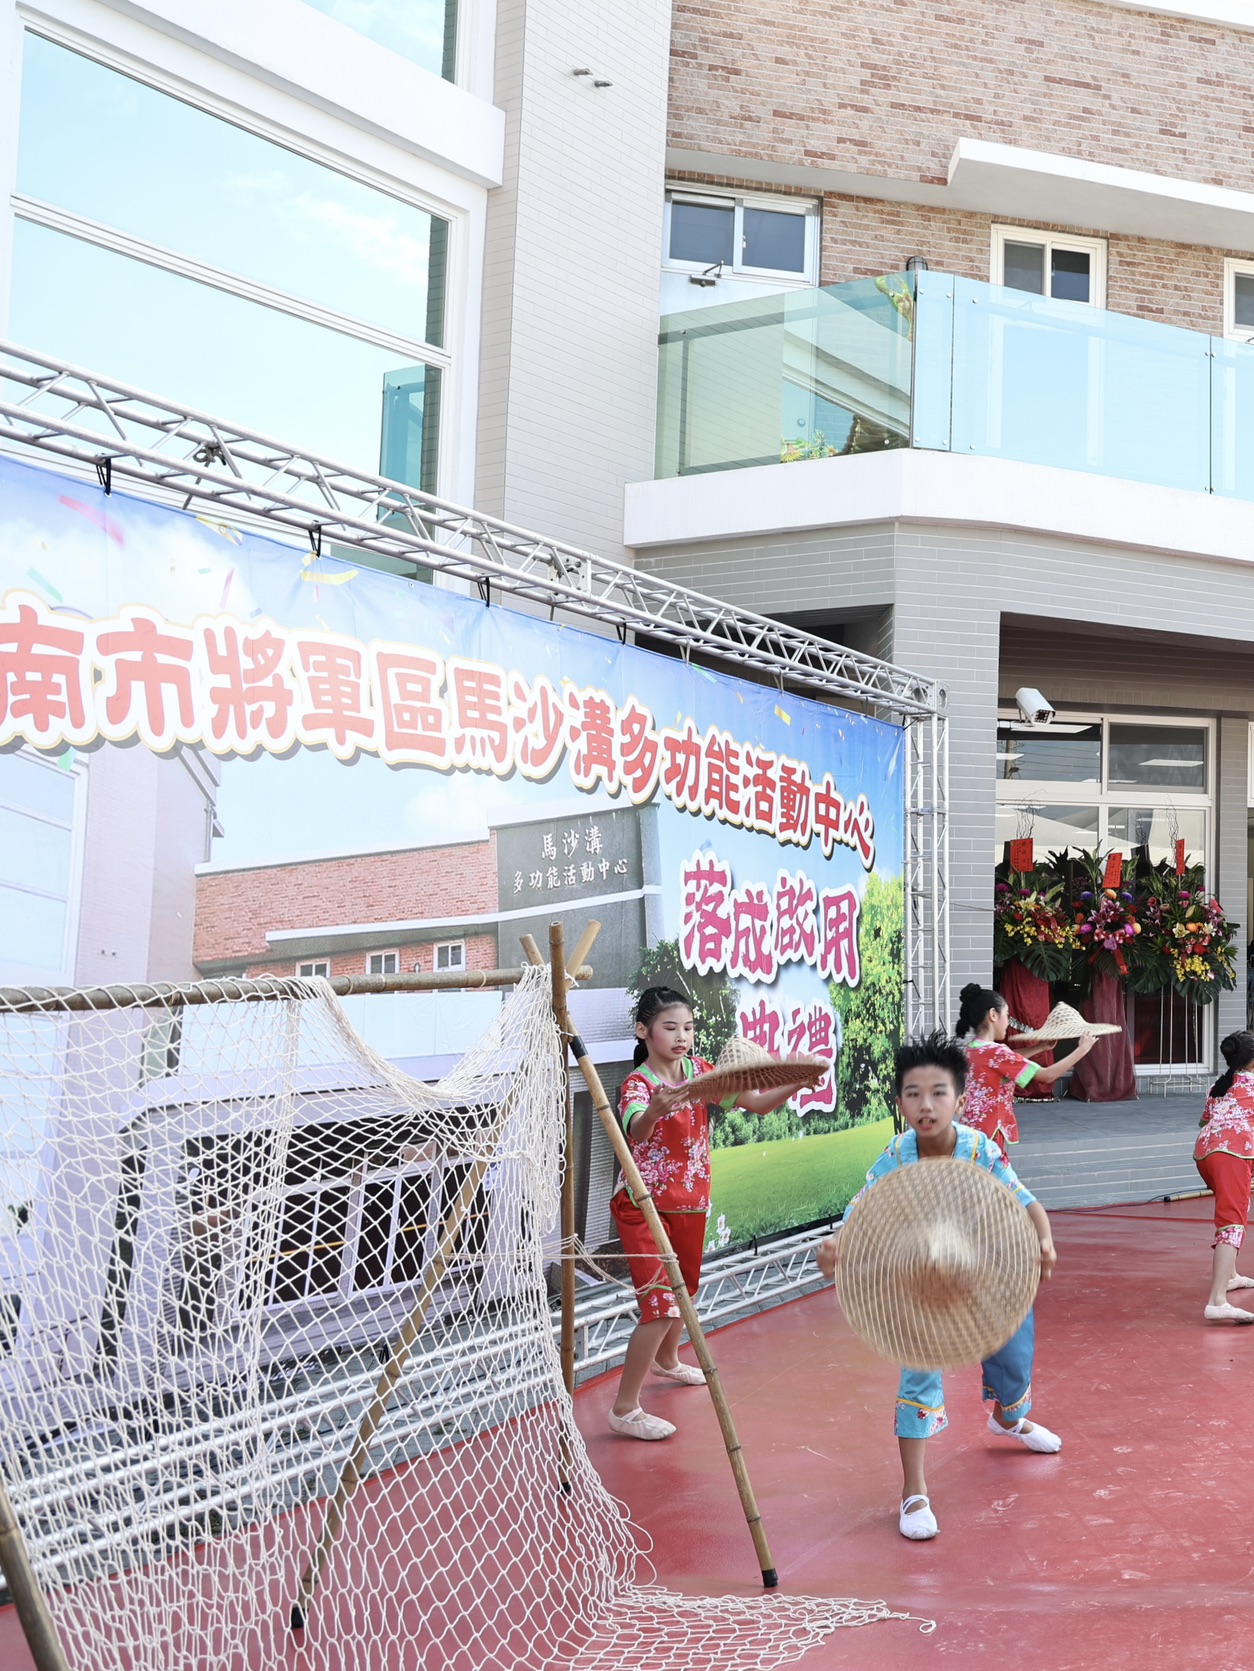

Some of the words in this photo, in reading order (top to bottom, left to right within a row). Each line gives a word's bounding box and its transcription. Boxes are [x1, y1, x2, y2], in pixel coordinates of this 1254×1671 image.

[0, 602, 875, 863] 南市將軍區馬沙溝多功能活動中心
[513, 857, 628, 894] 多功能活動中心
[541, 825, 603, 861] 馬沙溝
[684, 859, 857, 980] 落成啟用
